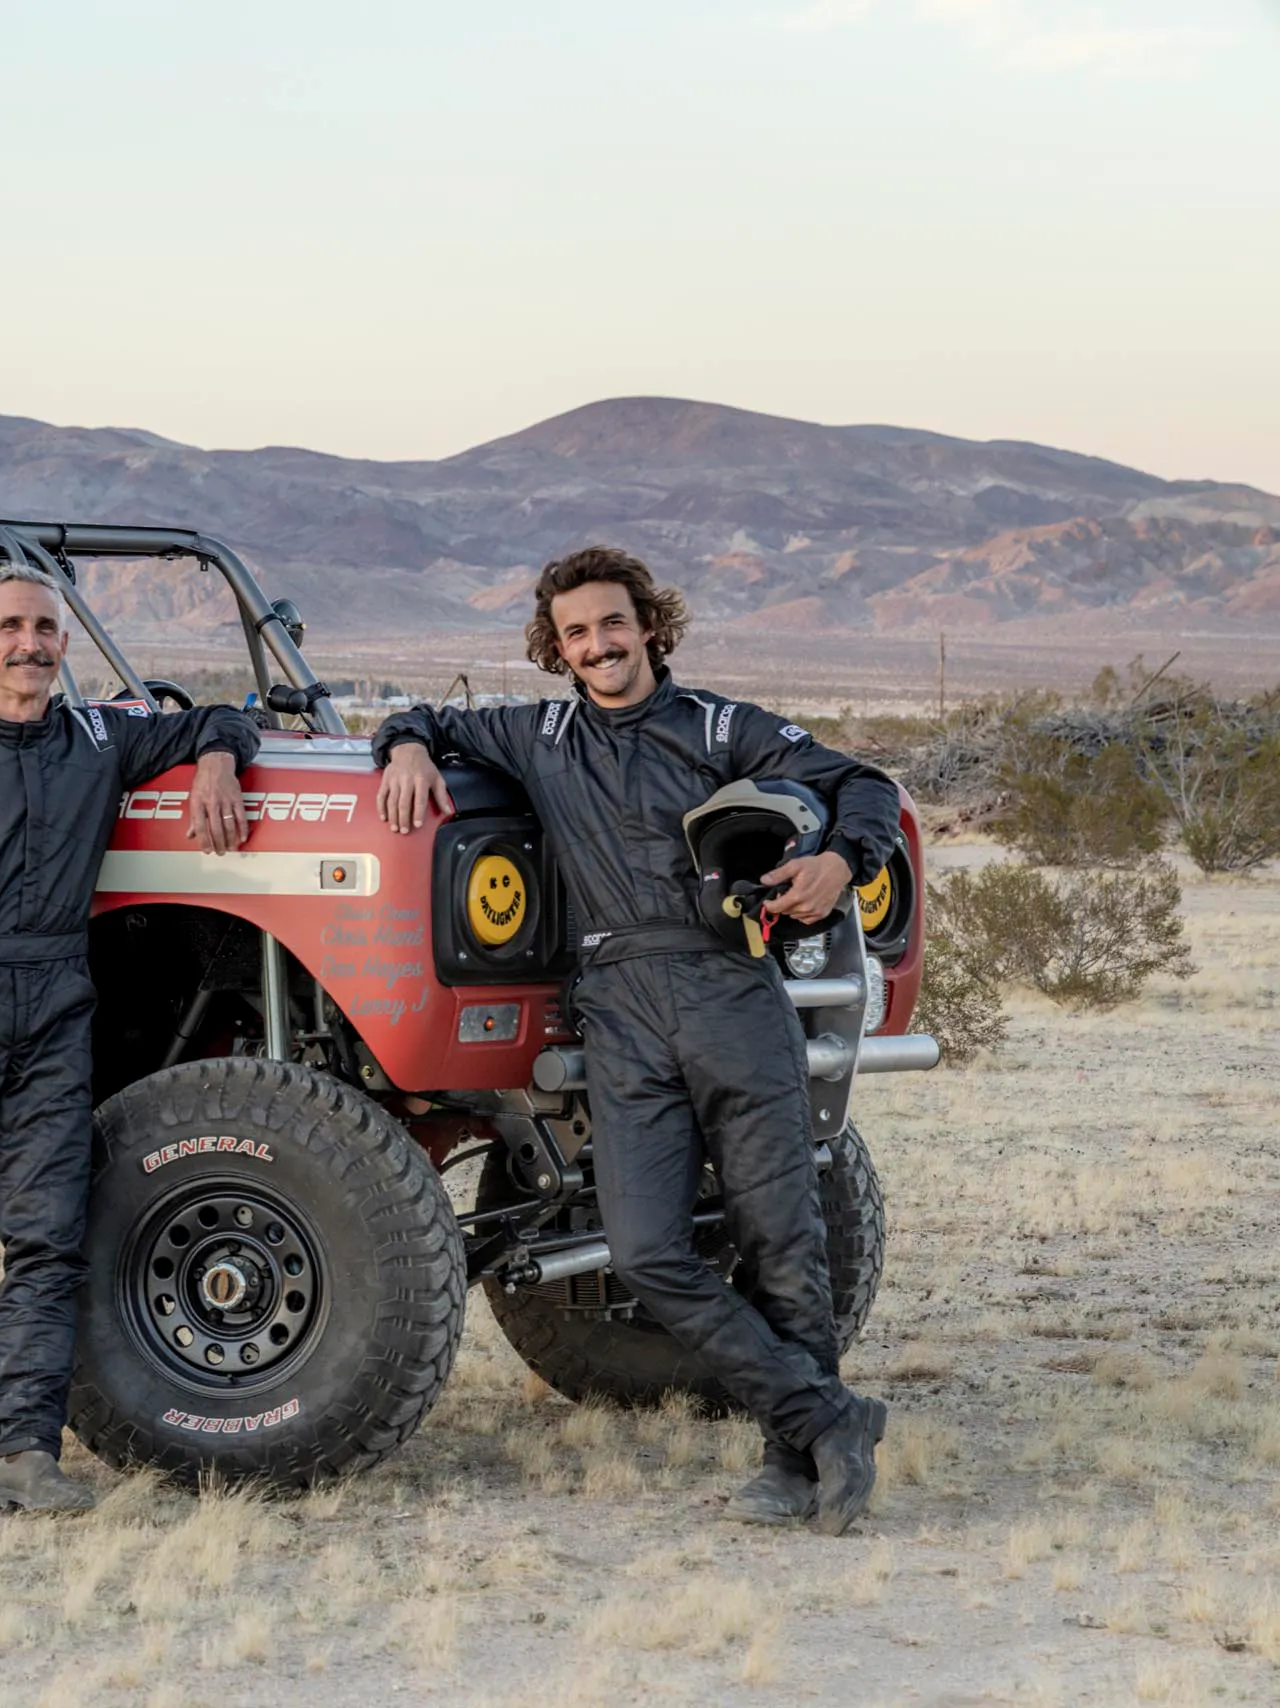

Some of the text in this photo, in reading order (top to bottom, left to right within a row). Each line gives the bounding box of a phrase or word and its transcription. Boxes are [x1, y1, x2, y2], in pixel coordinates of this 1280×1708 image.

[241, 792, 358, 823] ERRA
[480, 890, 521, 926] DAYLIGHTER
[143, 1136, 273, 1173] GENERAL
[162, 1398, 299, 1433] GRABBER
